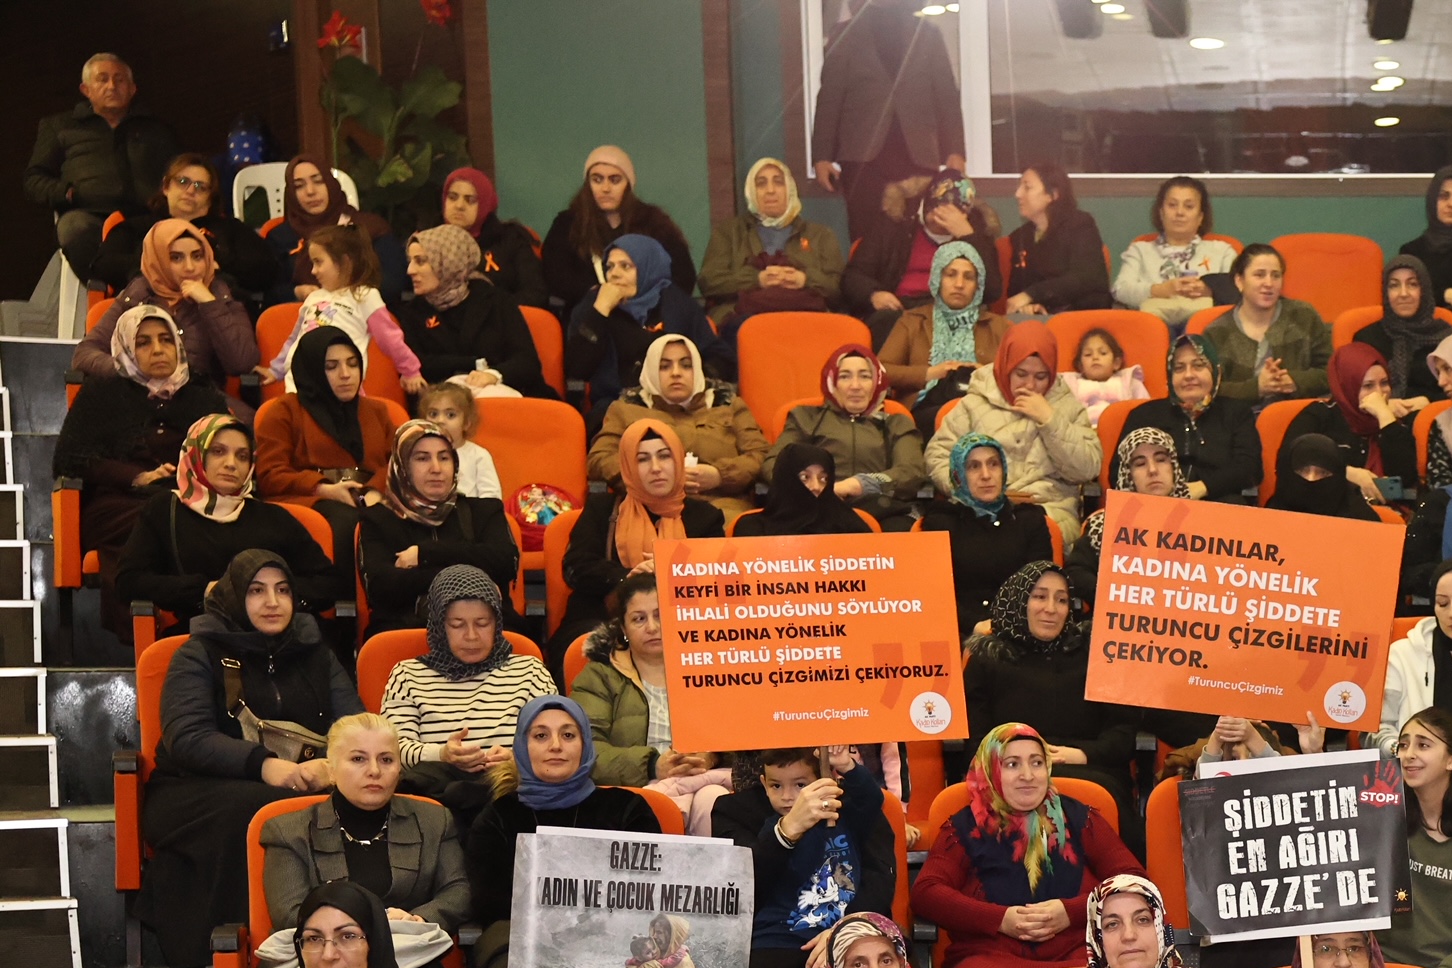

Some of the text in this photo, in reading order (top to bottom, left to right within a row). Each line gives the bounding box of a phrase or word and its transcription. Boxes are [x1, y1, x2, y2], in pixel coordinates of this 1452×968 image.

[1114, 527, 1285, 566] AK KADINLAR,
[672, 554, 894, 576] KADINA YÖNELİK ŞİDDETİN
[1112, 555, 1319, 596] KADINA YÖNELİK
[674, 580, 866, 598] KEYFİ BİR İNSAN HAKKI
[677, 598, 922, 621] İHLALİ OLDUĞUNU SÖYLÜYOR
[1109, 583, 1341, 627] HER TÜRLÜ ŞİDDETE
[678, 621, 847, 643] VE KADINA YÖNELİK
[1106, 612, 1368, 659] TURUNCU ÇİZGİLERİNİ
[681, 645, 842, 666] HER TÜRLÜ ŞİDDETE
[1103, 640, 1208, 669] ÇEKİYOR.
[682, 663, 948, 688] TURUNCU ÇİZGİMİZİ ÇEKİYORUZ.
[1188, 676, 1284, 696] #TuruncuÇizgimiz
[773, 707, 869, 721] #TuruncuÇizgimiz
[1223, 779, 1359, 838] ŞİDDETİN
[1360, 791, 1398, 804] STOP!
[610, 840, 662, 872] GAZZE:
[1228, 826, 1360, 875] EN AĞIRI
[1409, 859, 1424, 873] UST
[583, 878, 603, 908] VE
[606, 880, 655, 913] ÇOCUK
[659, 882, 740, 916] MEZARLIĞI
